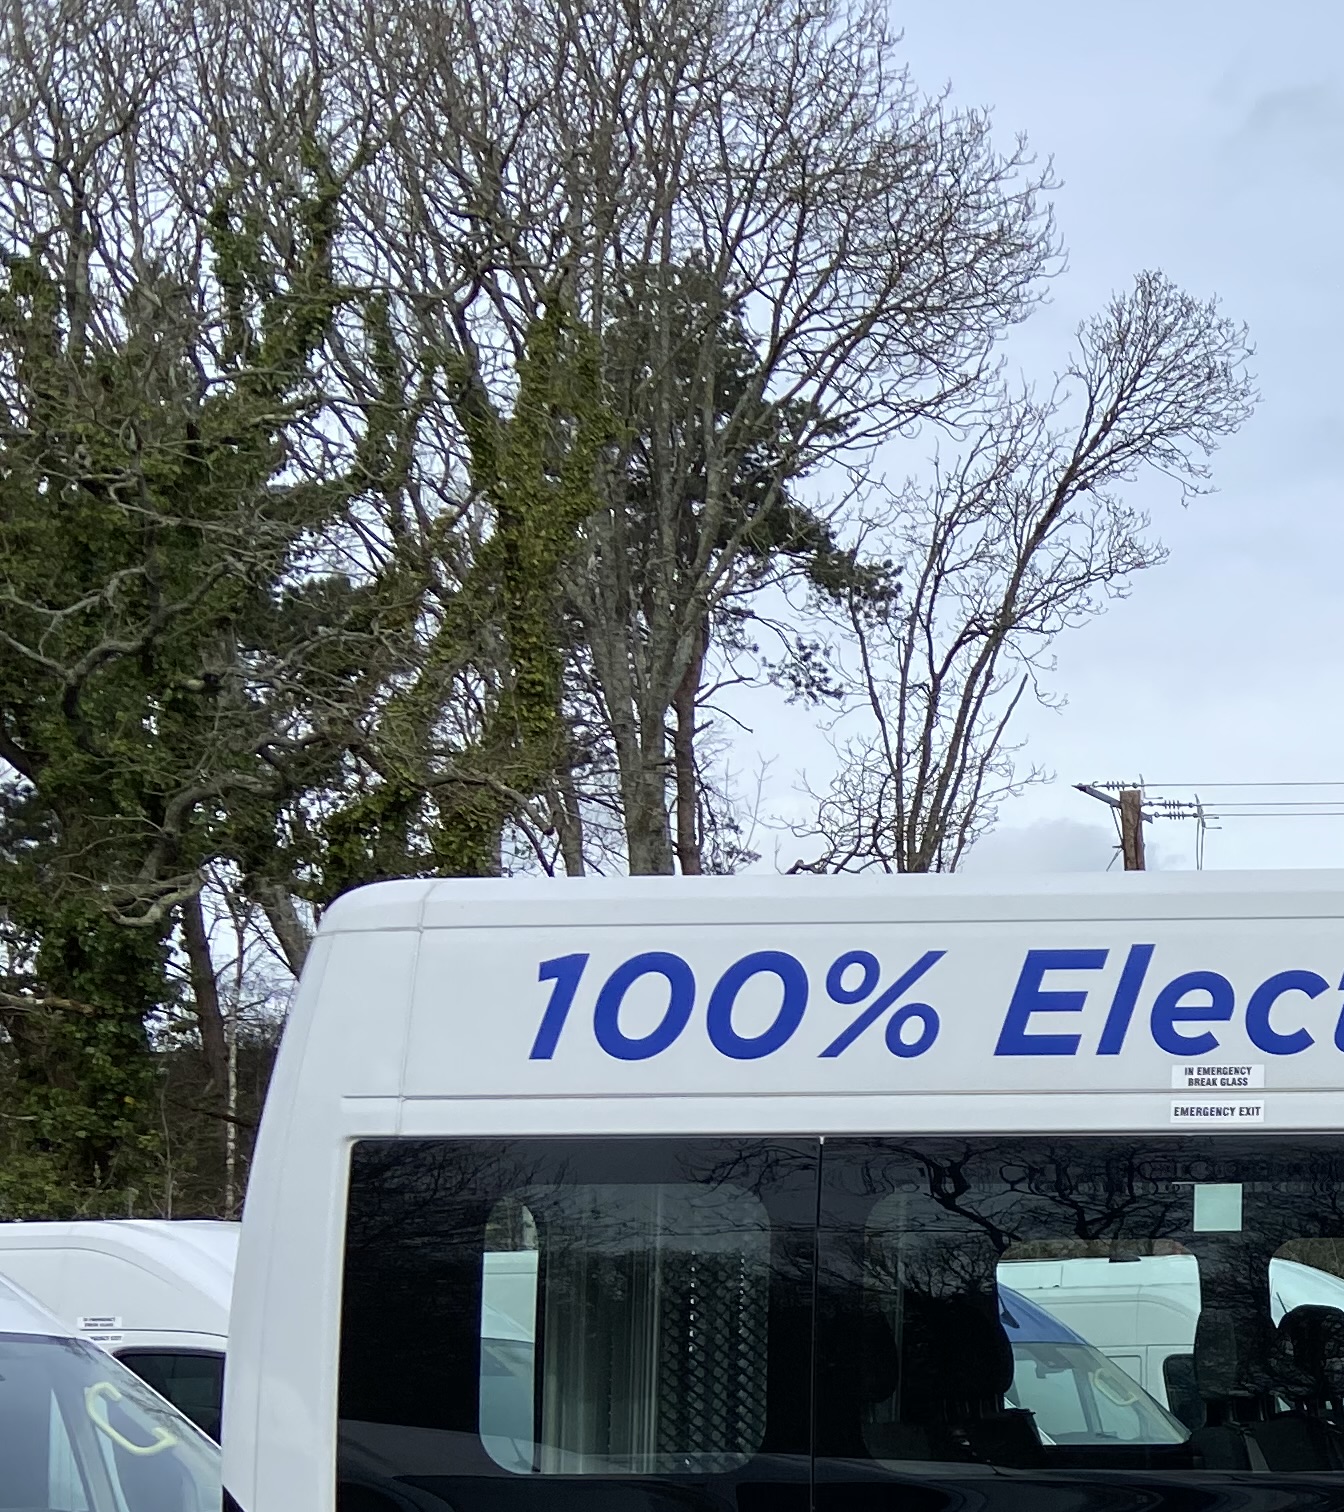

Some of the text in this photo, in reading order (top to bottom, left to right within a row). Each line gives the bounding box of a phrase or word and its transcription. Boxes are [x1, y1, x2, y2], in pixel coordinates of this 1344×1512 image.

[528, 949, 946, 1062] 100%
[1184, 1066, 1252, 1076] IN EMERGENCY
[1188, 1077, 1249, 1087] BREAK GLASS
[1173, 1106, 1262, 1117] EMERGENCY EXIT
